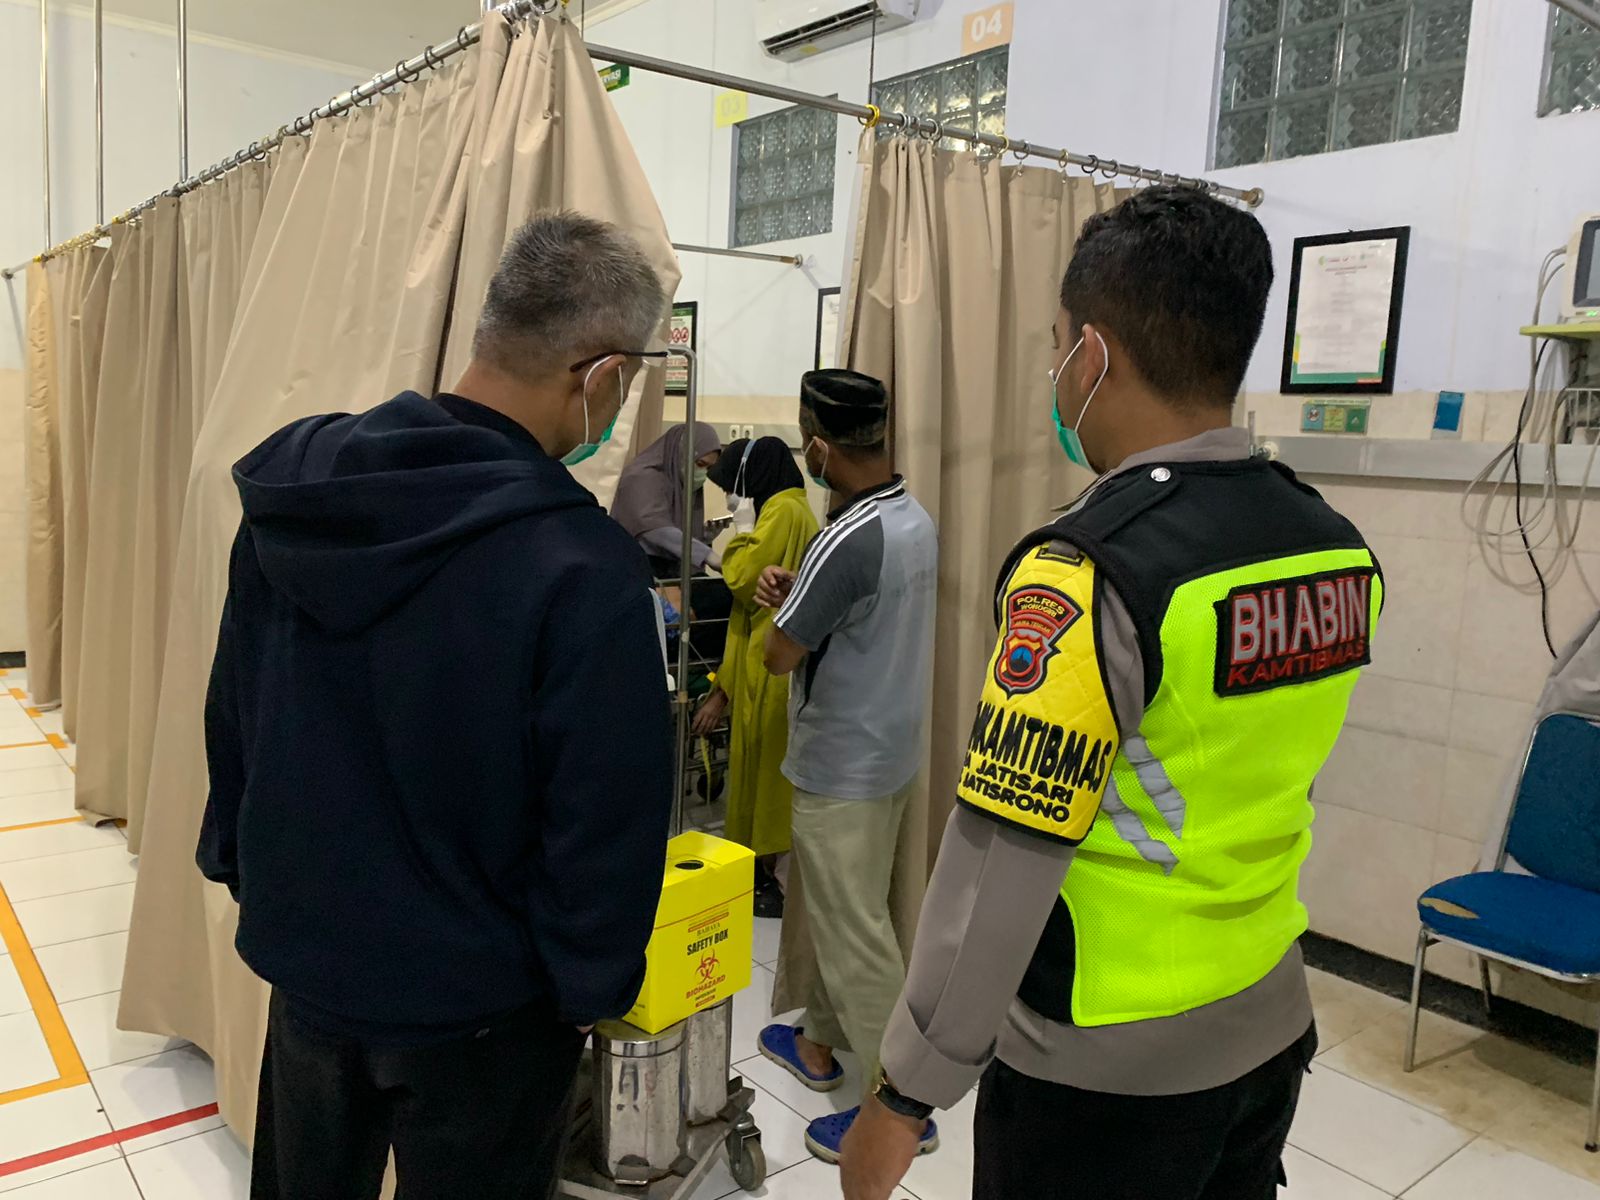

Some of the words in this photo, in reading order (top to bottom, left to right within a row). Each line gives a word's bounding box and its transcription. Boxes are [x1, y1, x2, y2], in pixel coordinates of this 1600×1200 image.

[970, 8, 1002, 42] 04
[721, 96, 741, 118] 03
[1017, 595, 1066, 615] POLRES
[1231, 575, 1369, 665] BHABIN
[1227, 639, 1366, 688] KAMTIBMAS
[963, 772, 1070, 823] JATISRONO
[976, 759, 1075, 805] JATISARI
[687, 935, 714, 956] SAFETY
[714, 928, 729, 945] BOX
[686, 974, 726, 999] BIOHAZARD
